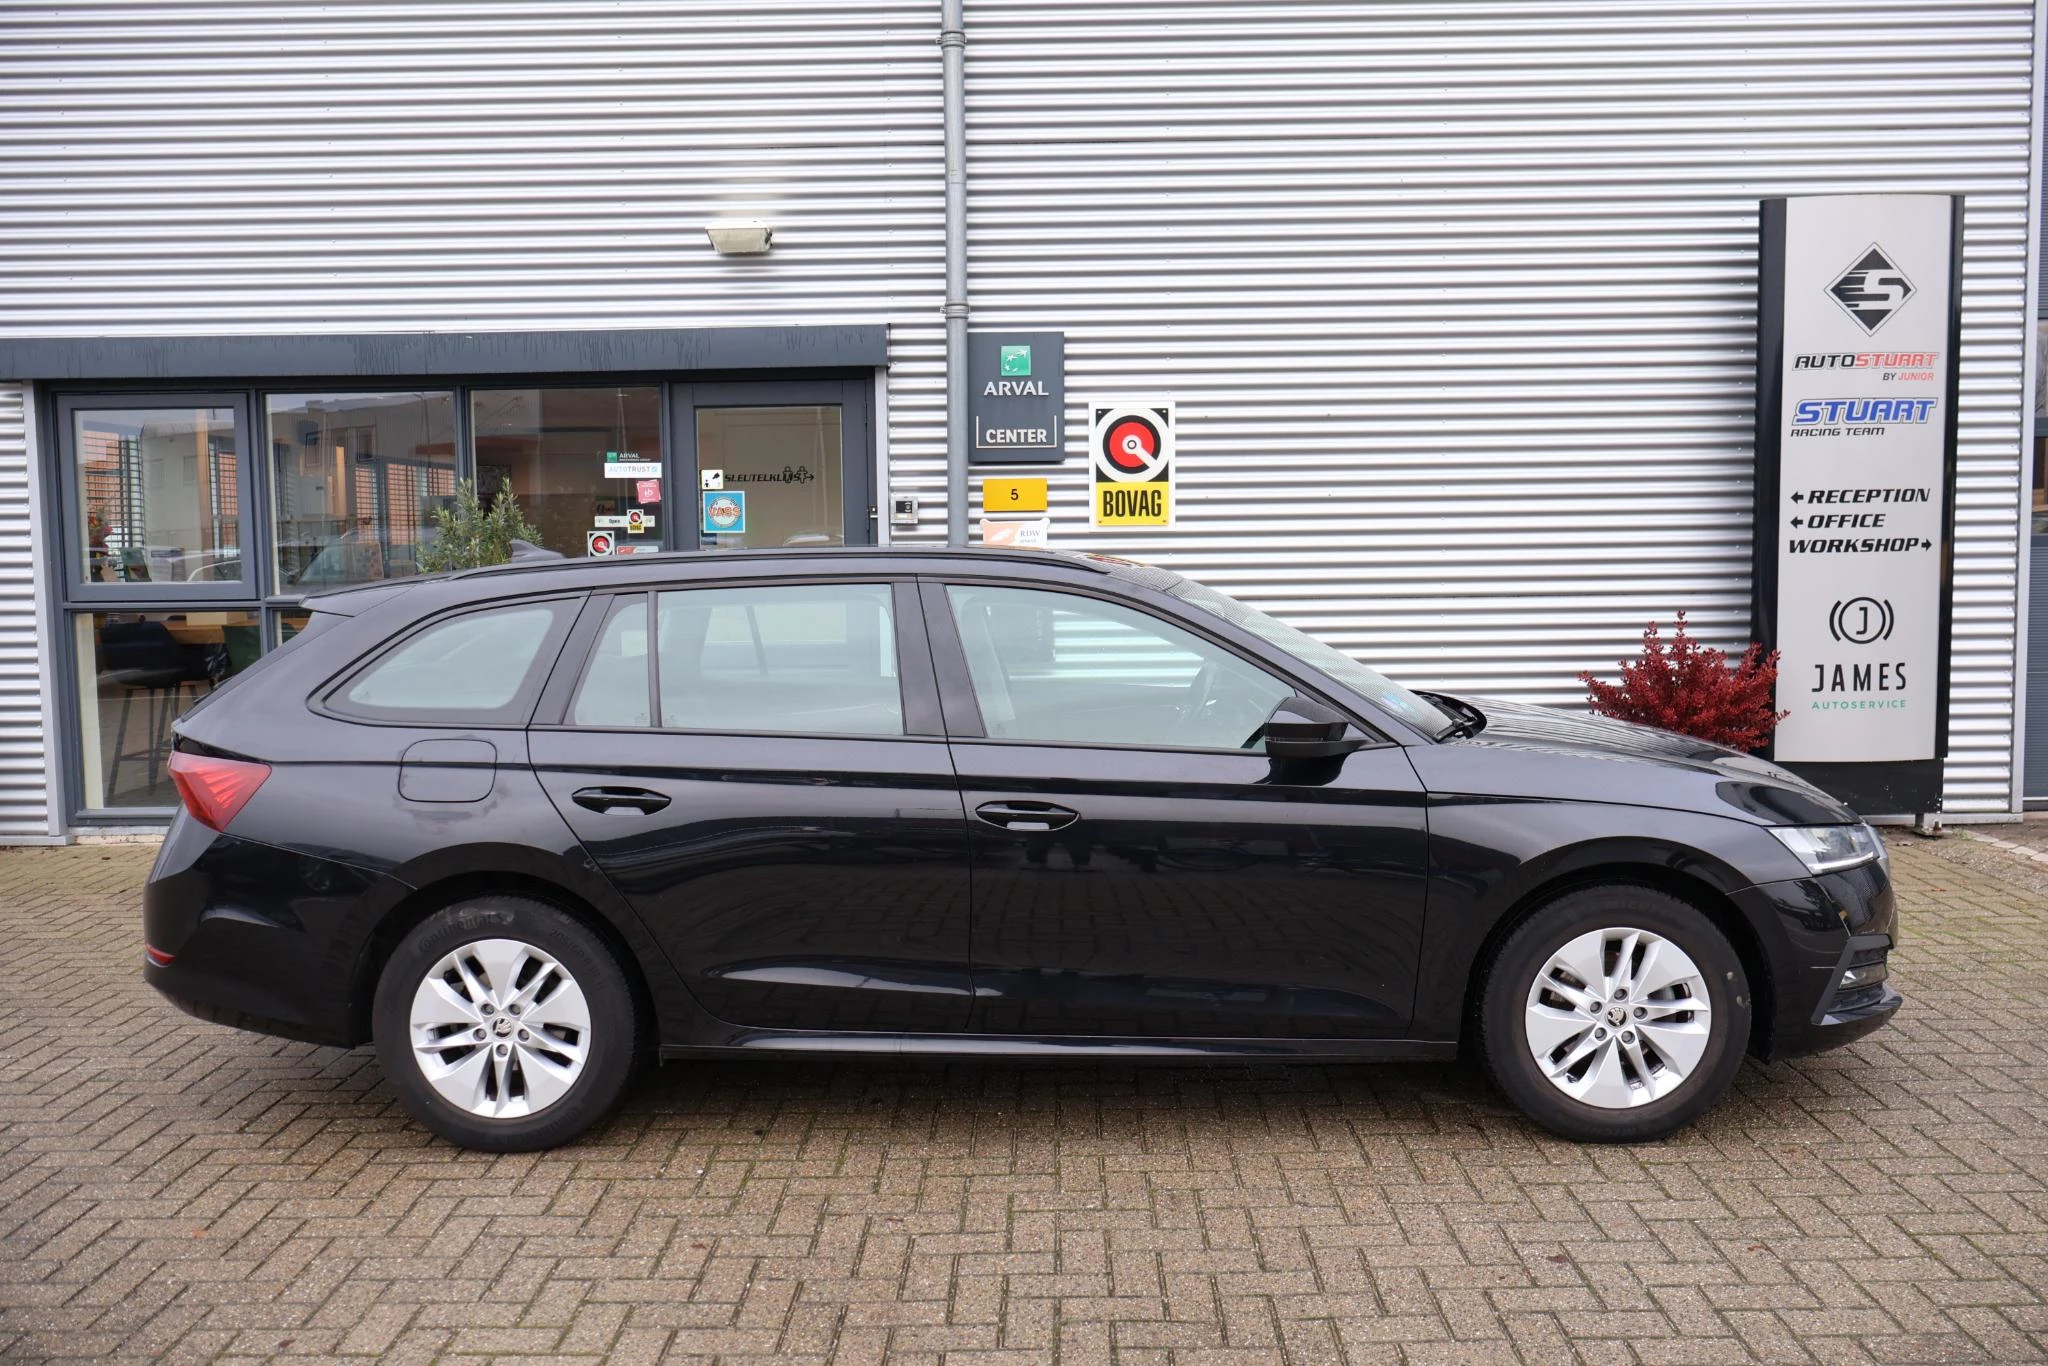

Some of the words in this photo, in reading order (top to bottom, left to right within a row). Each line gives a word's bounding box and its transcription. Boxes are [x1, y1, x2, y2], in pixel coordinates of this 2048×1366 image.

[1882, 372, 1896, 381] BY
[1898, 372, 1934, 381] JUNIOR
[983, 381, 1049, 396] ARVAL
[1793, 399, 1937, 425] STUART
[985, 429, 1047, 444] CENTER
[1790, 428, 1841, 437] RACING
[1846, 427, 1885, 437] TEAM
[608, 465, 650, 473] AUTOTRUST
[1010, 488, 1019, 501] 5
[1807, 488, 1931, 504] RECEPTION
[1102, 489, 1162, 518] BOVAG
[1807, 513, 1887, 529] OFFICE
[1020, 529, 1041, 537] RDW
[1788, 537, 1920, 554] WORKSHOP
[1811, 662, 1907, 693] JAMES
[1811, 699, 1906, 710] AUTOSERVICE
